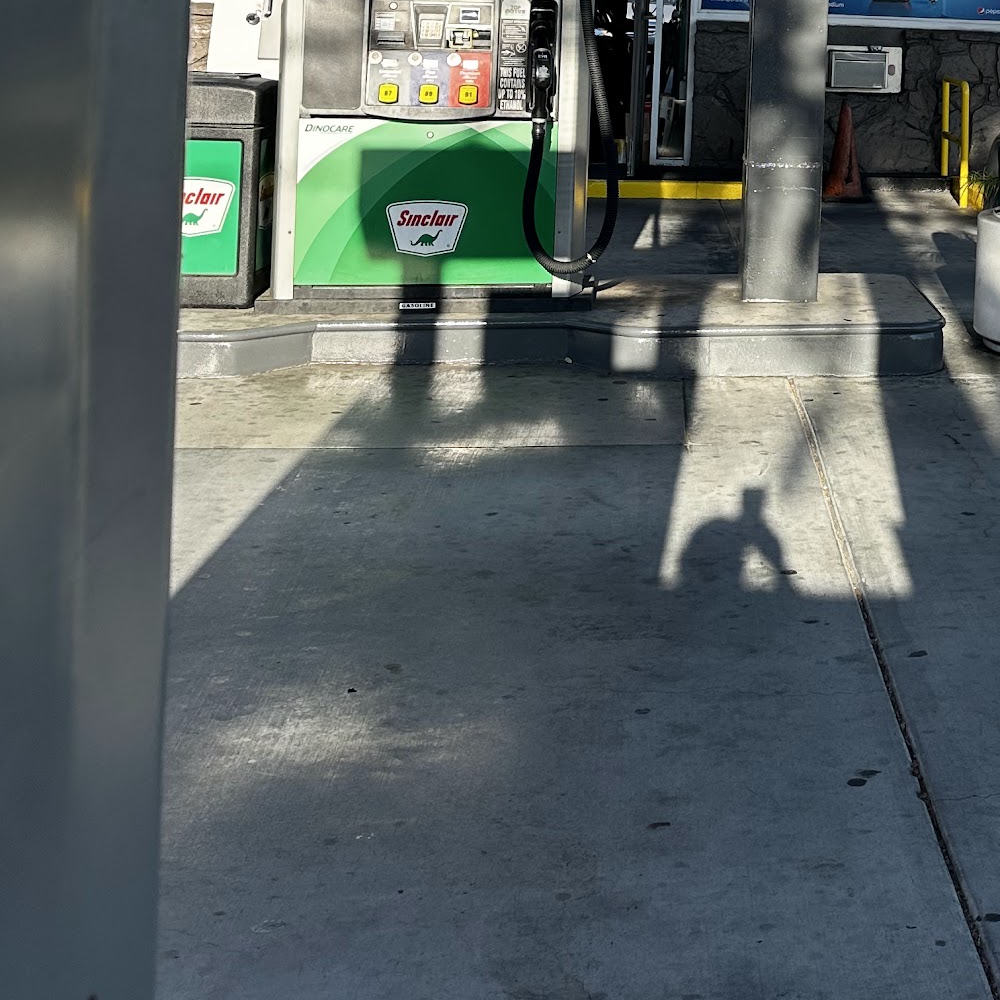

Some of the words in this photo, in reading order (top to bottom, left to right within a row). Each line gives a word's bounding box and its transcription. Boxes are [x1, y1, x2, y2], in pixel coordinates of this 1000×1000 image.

[500, 67, 512, 78] THIS
[513, 67, 526, 78] FUEL
[500, 78, 526, 88] CONTAINS
[498, 89, 506, 99] UP
[506, 89, 514, 99] TO
[514, 89, 526, 100] 10%
[500, 99, 524, 110] ETHANOL
[396, 209, 459, 227] Sinclair
